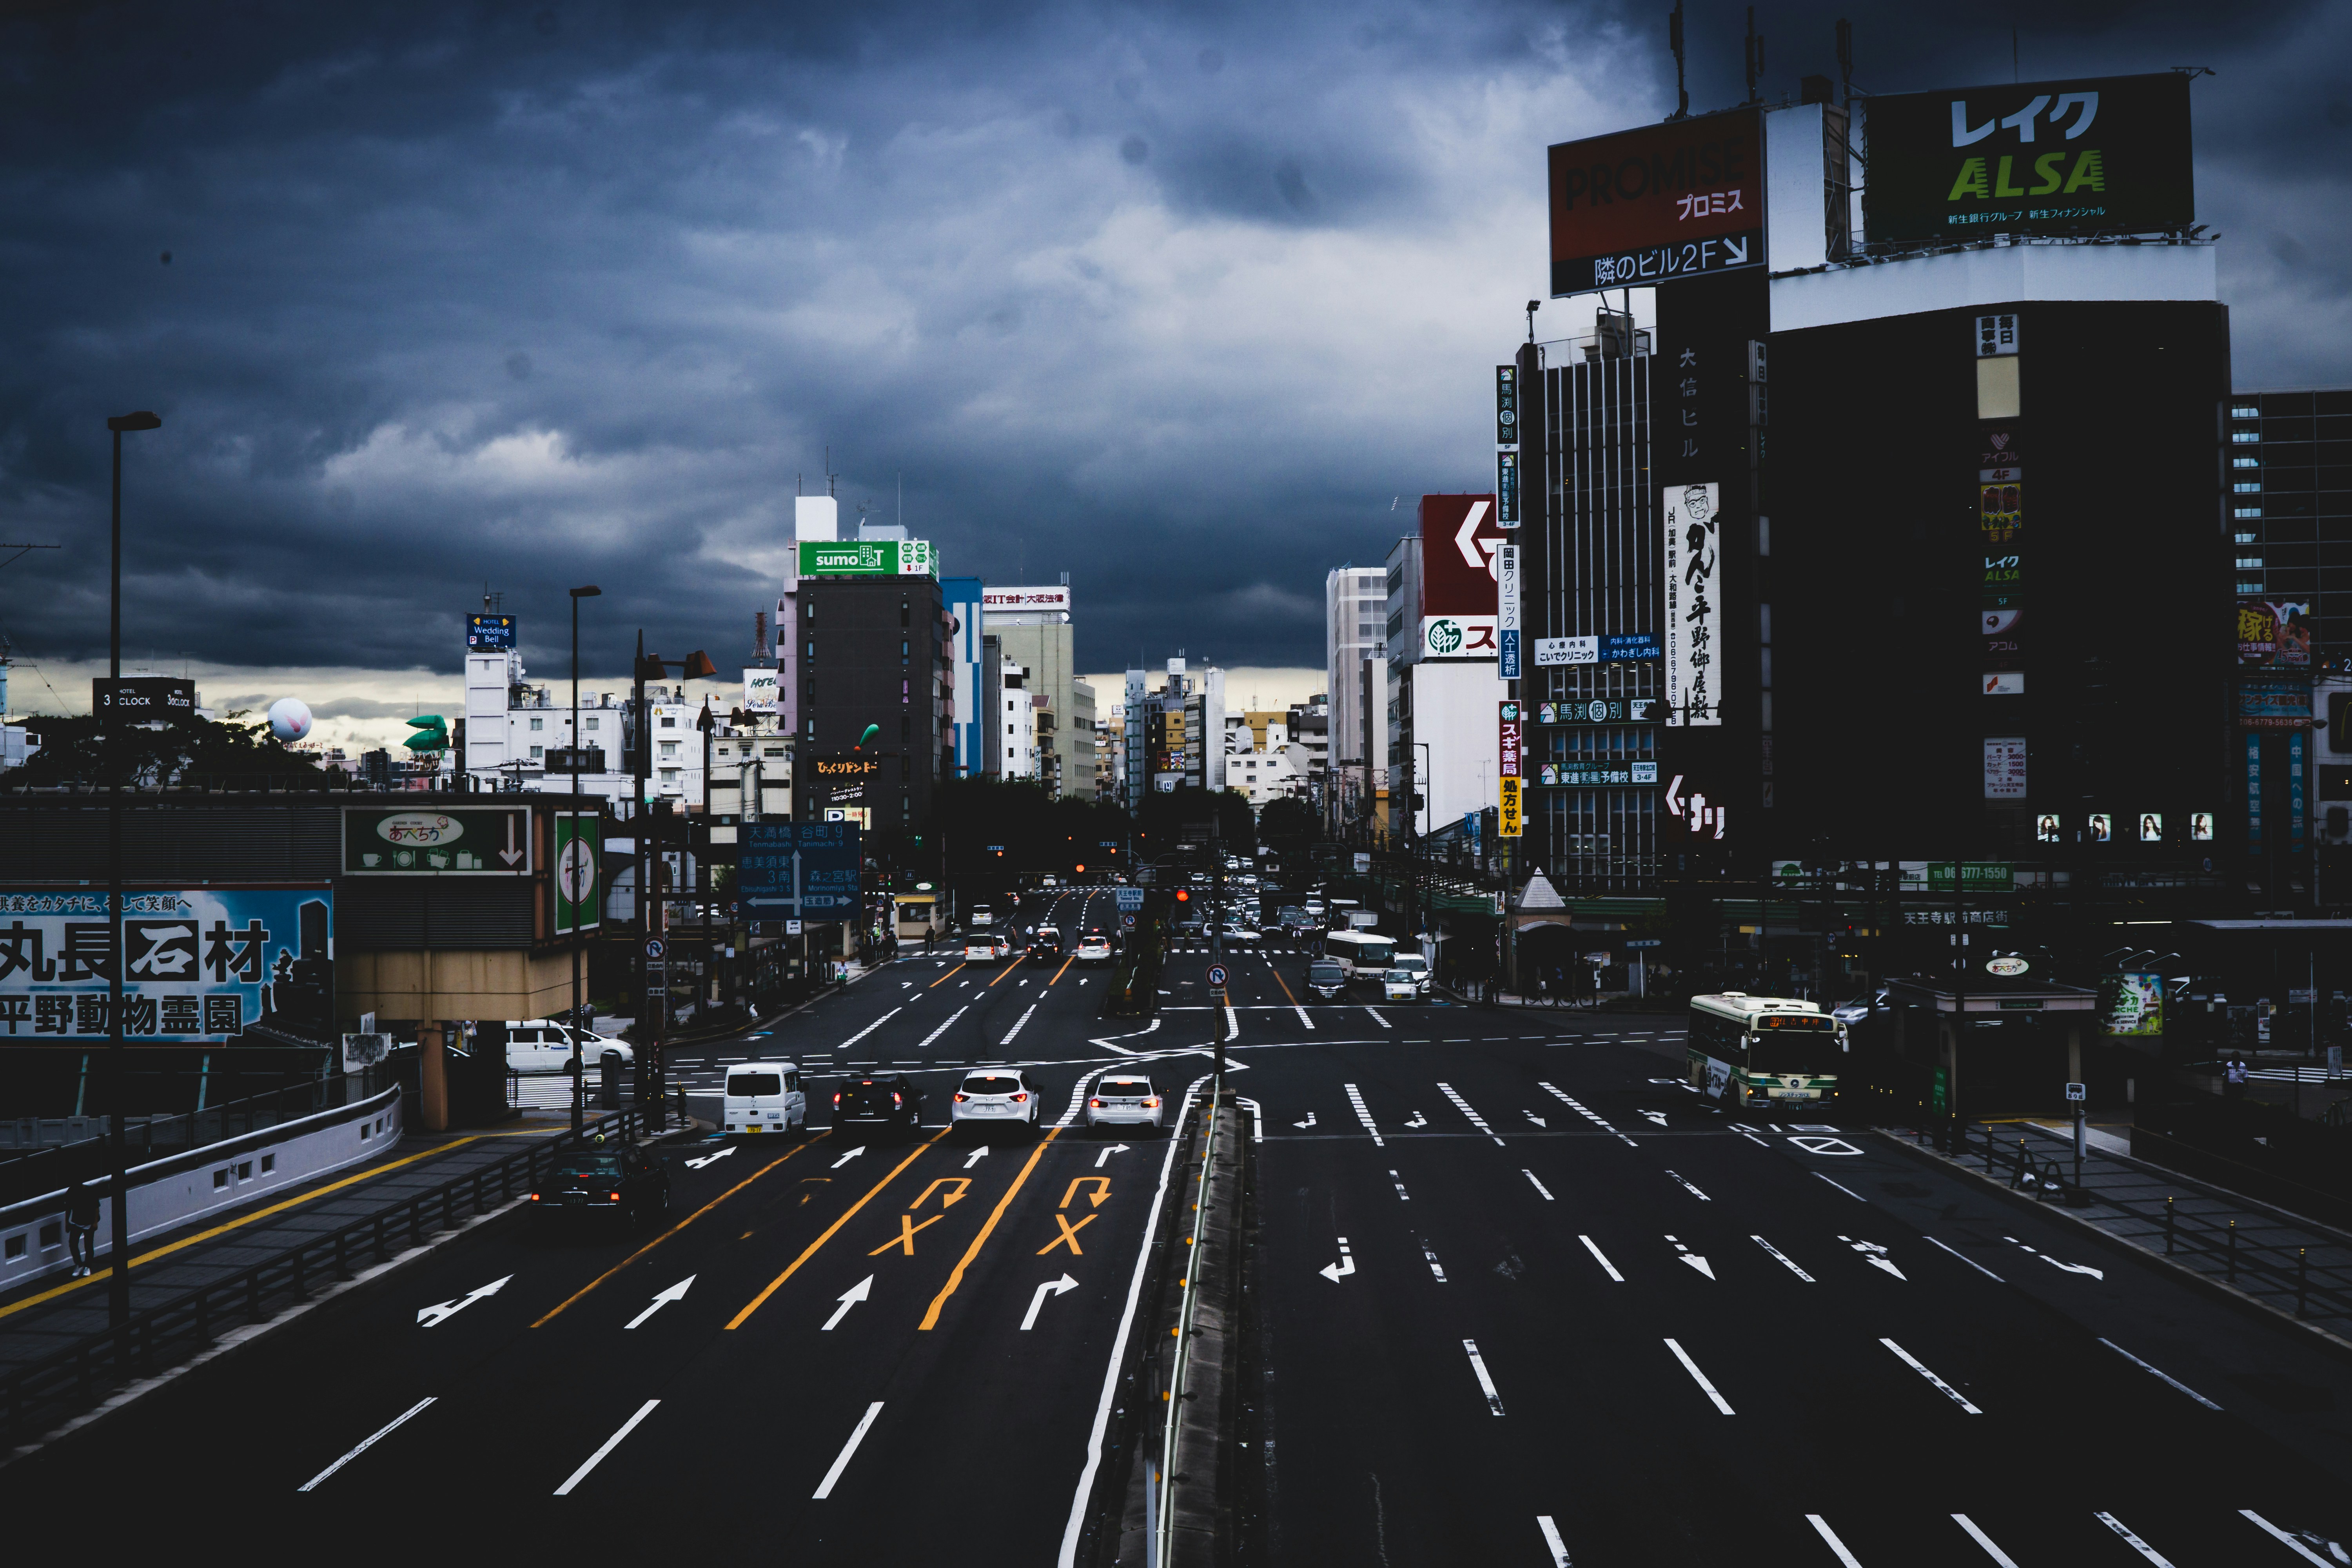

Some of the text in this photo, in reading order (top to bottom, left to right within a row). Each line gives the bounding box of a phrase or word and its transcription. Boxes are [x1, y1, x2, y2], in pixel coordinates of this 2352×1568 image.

[1952, 92, 2099, 147] レイク
[1565, 136, 1744, 211] PROMISE
[1947, 150, 2105, 201] ALSA
[1677, 189, 1744, 221] プロミス
[1948, 207, 2105, 225] 新生銀行グループ 新生フィナンシャル
[1595, 240, 1717, 286] 隣のビル2F
[1999, 316, 2013, 344] 毎日
[1680, 348, 1698, 457] 大信ビル
[1982, 451, 2019, 463] アイフル
[1992, 469, 2010, 480] 4F
[1985, 555, 2019, 569] レイク
[1985, 570, 2020, 581] ALSA
[1504, 548, 1515, 627] 岡田クリニック
[983, 593, 1064, 604] 阪IT会計 大阪法律
[474, 626, 509, 636] Wedding
[2237, 609, 2274, 642] 稼げる
[1548, 640, 1586, 649] 心療内科
[1610, 636, 1650, 646] 内科・消化器科
[1989, 641, 2018, 652] アコム
[1504, 632, 1515, 675] 人工透析
[1540, 650, 1594, 662] こいでクリニック
[1612, 646, 1660, 659] かわぎし内科
[1502, 724, 1520, 775] スギ薬局
[1504, 779, 1517, 833] 処方せん
[749, 826, 791, 839] 天満橋
[742, 856, 789, 869] 恵美須東
[809, 869, 857, 882] 森之宮駅
[1933, 870, 1943, 878] TEL
[806, 897, 831, 906] 玉造筋
[0, 919, 270, 983] 丸長石材
[0, 994, 243, 1035] 平野動物霊園
